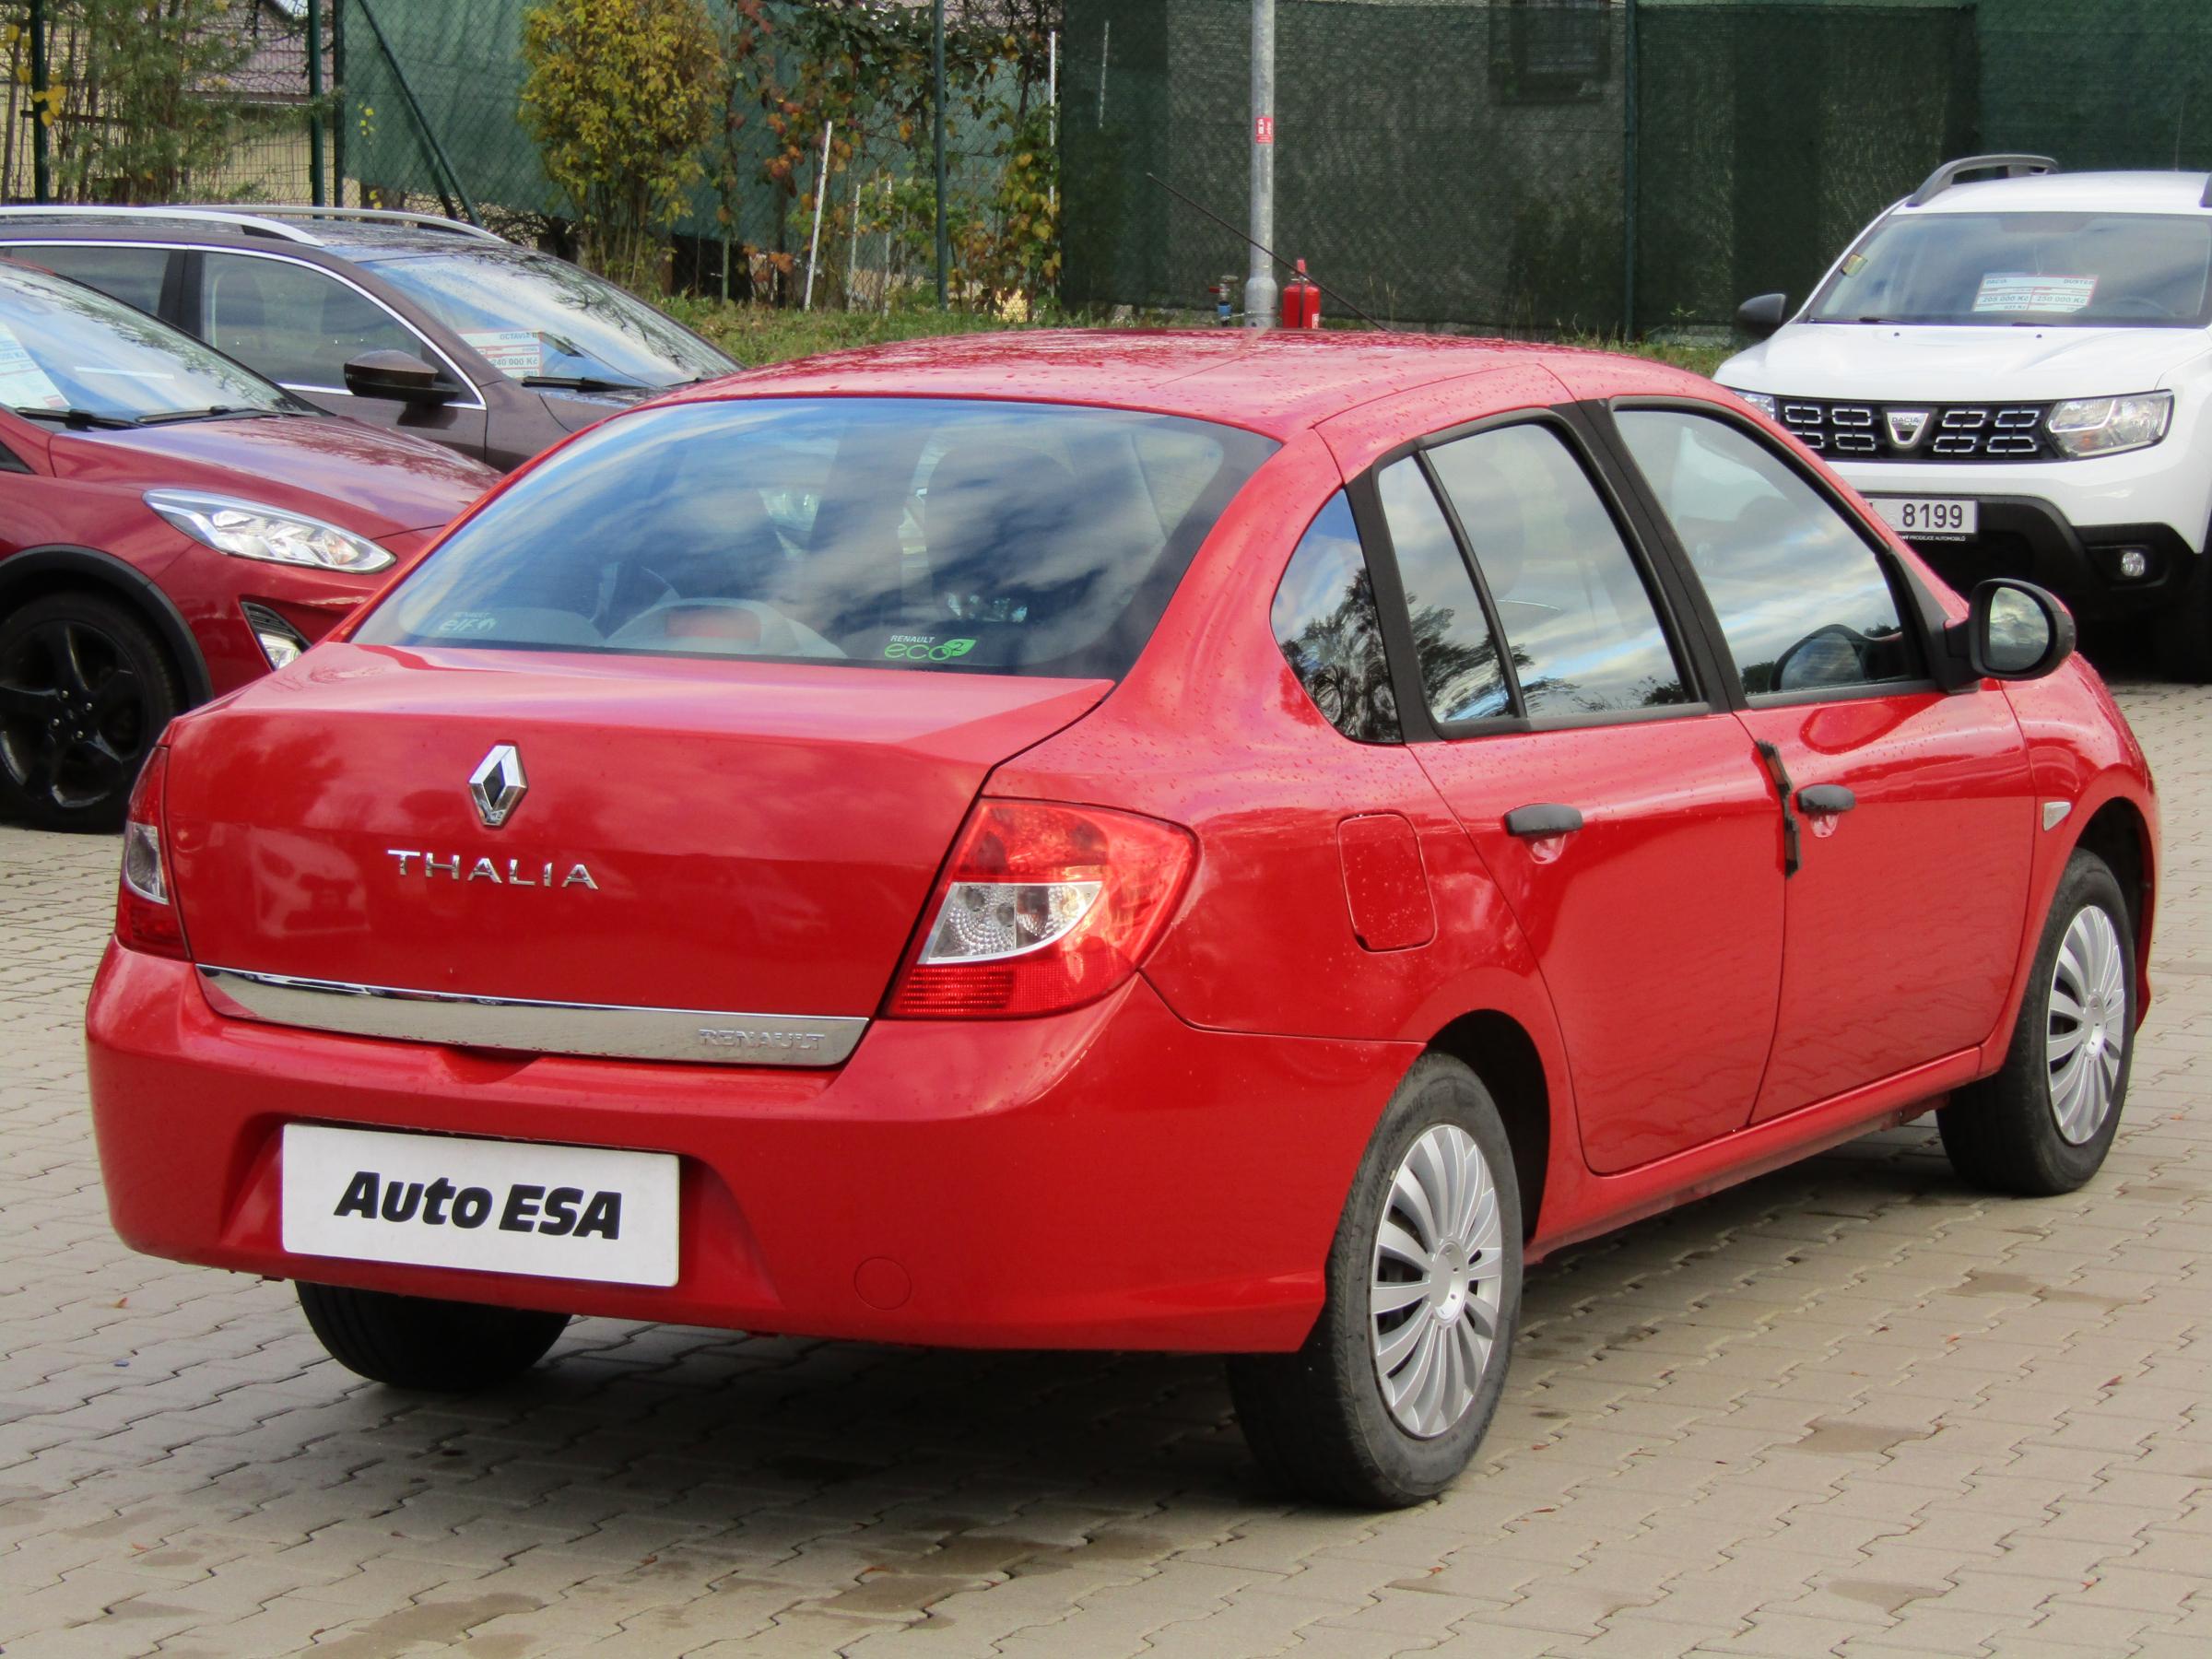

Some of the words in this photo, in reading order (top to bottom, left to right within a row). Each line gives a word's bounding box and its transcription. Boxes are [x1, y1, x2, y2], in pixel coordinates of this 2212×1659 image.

[509, 357, 524, 366] 000
[1901, 502, 1963, 529] 8199
[890, 635, 935, 643] RENAULT
[387, 849, 599, 890] THALIA
[699, 1029, 826, 1051] RENAULT
[333, 1171, 493, 1229] Auto
[499, 1183, 622, 1240] ESA
